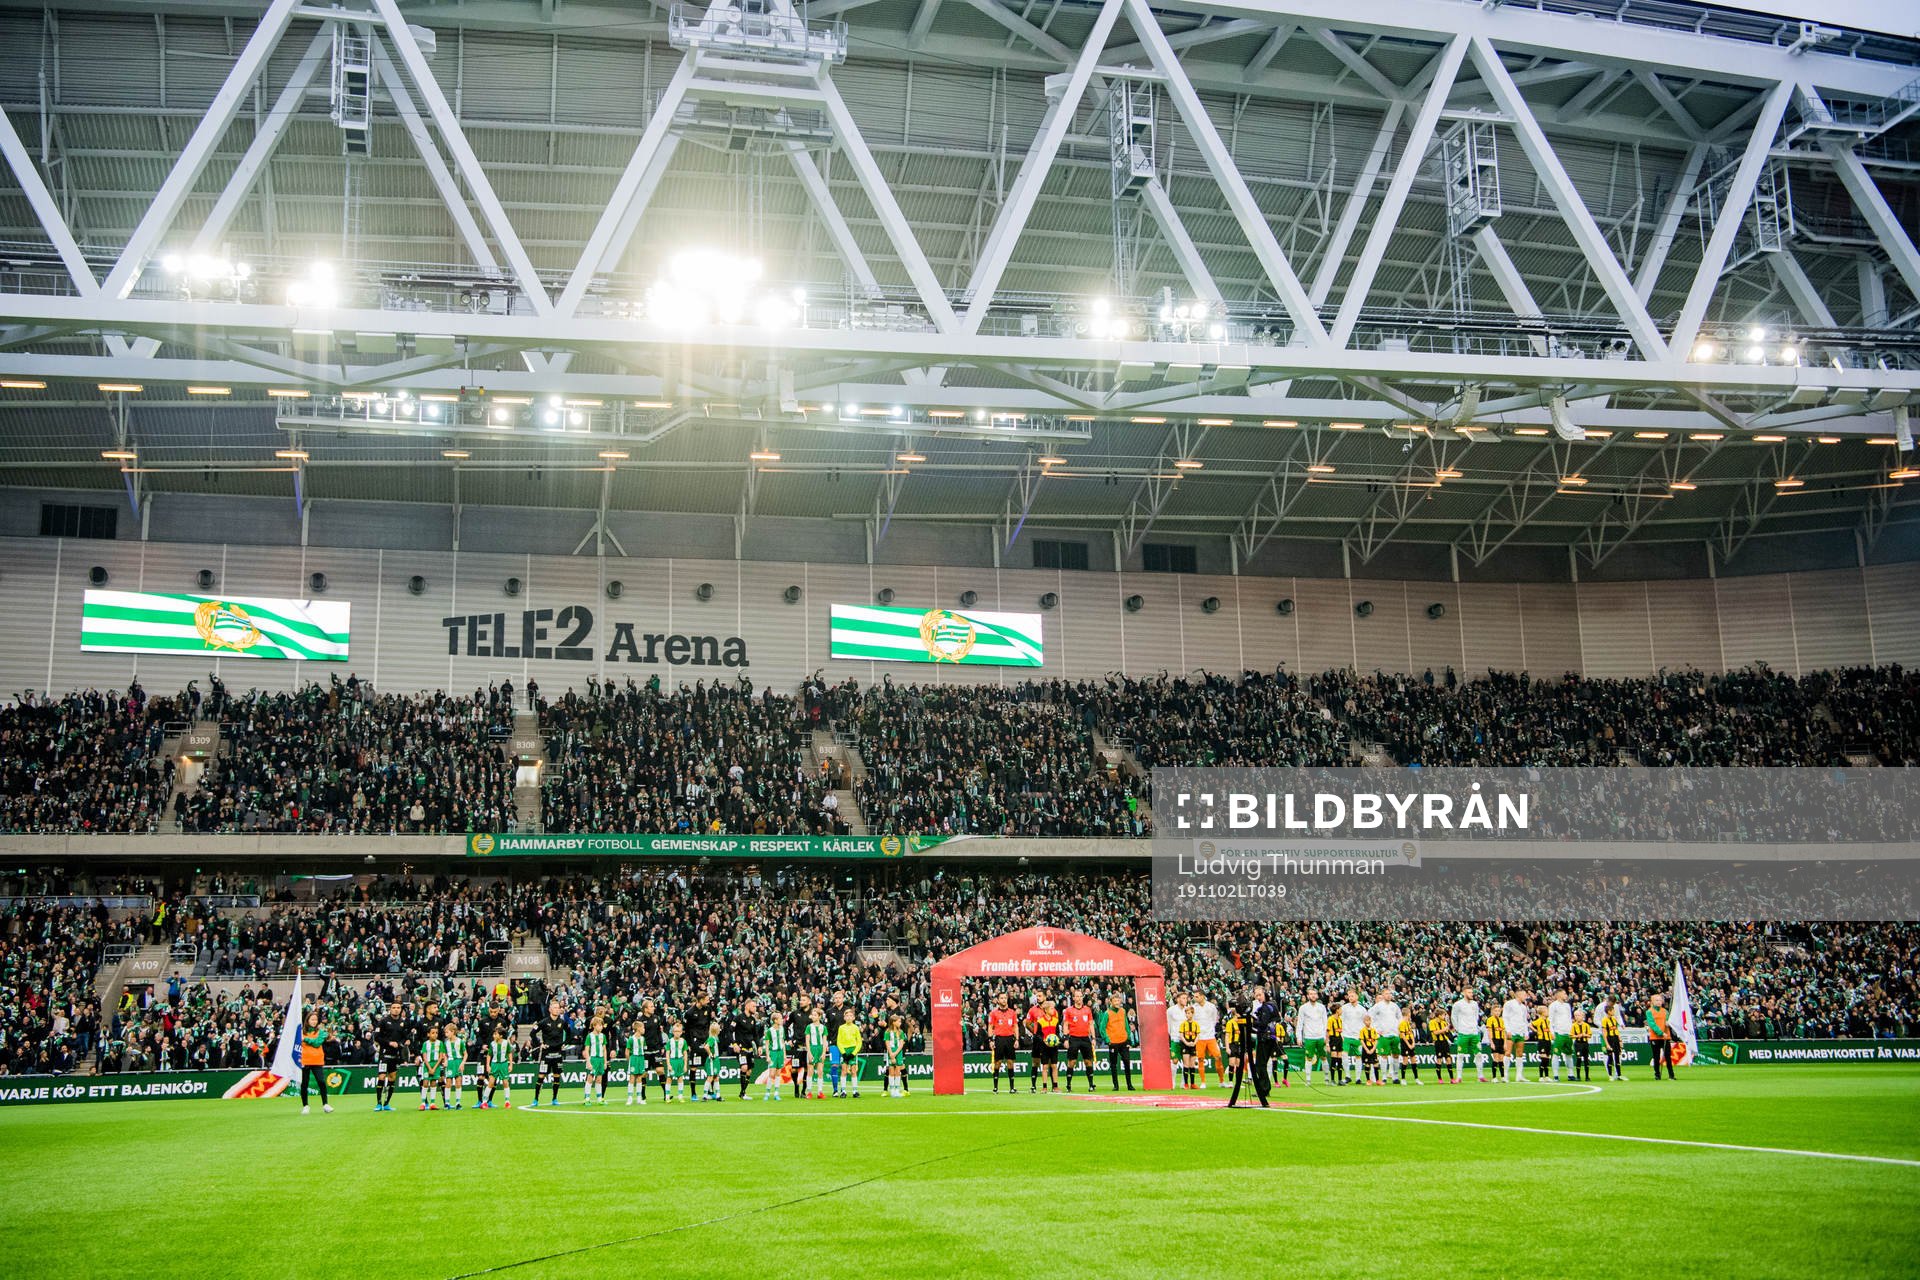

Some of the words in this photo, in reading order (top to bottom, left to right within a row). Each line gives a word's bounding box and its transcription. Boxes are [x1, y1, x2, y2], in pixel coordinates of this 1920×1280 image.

[442, 605, 593, 661] TELE2
[605, 622, 750, 667] Arena
[190, 736, 211, 745] B309
[516, 741, 536, 749] B308
[500, 838, 585, 849] HAMMARBY
[588, 839, 644, 849] FOTBOLL
[651, 840, 738, 850] GEMENSKAP
[750, 841, 811, 851] RESPEKT
[823, 838, 875, 852] KÄRLEK
[1303, 848, 1398, 858] SUPPORTERKULTUR
[515, 955, 539, 965] A108
[866, 952, 888, 961] A107
[132, 960, 159, 970] A109
[981, 959, 1019, 972] Framåt
[1021, 959, 1037, 972] för
[1038, 959, 1073, 972] svensk
[1074, 959, 1113, 972] fotboll!
[1749, 1049, 1772, 1060] MED
[1774, 1048, 1875, 1059] HAMMARBYKORTET
[1877, 1046, 1892, 1058] ÄR
[0, 1087, 49, 1100] VARJE
[52, 1083, 85, 1098] KÖP
[88, 1085, 118, 1097] ETT
[121, 1080, 208, 1096] BAJENKÖP!
